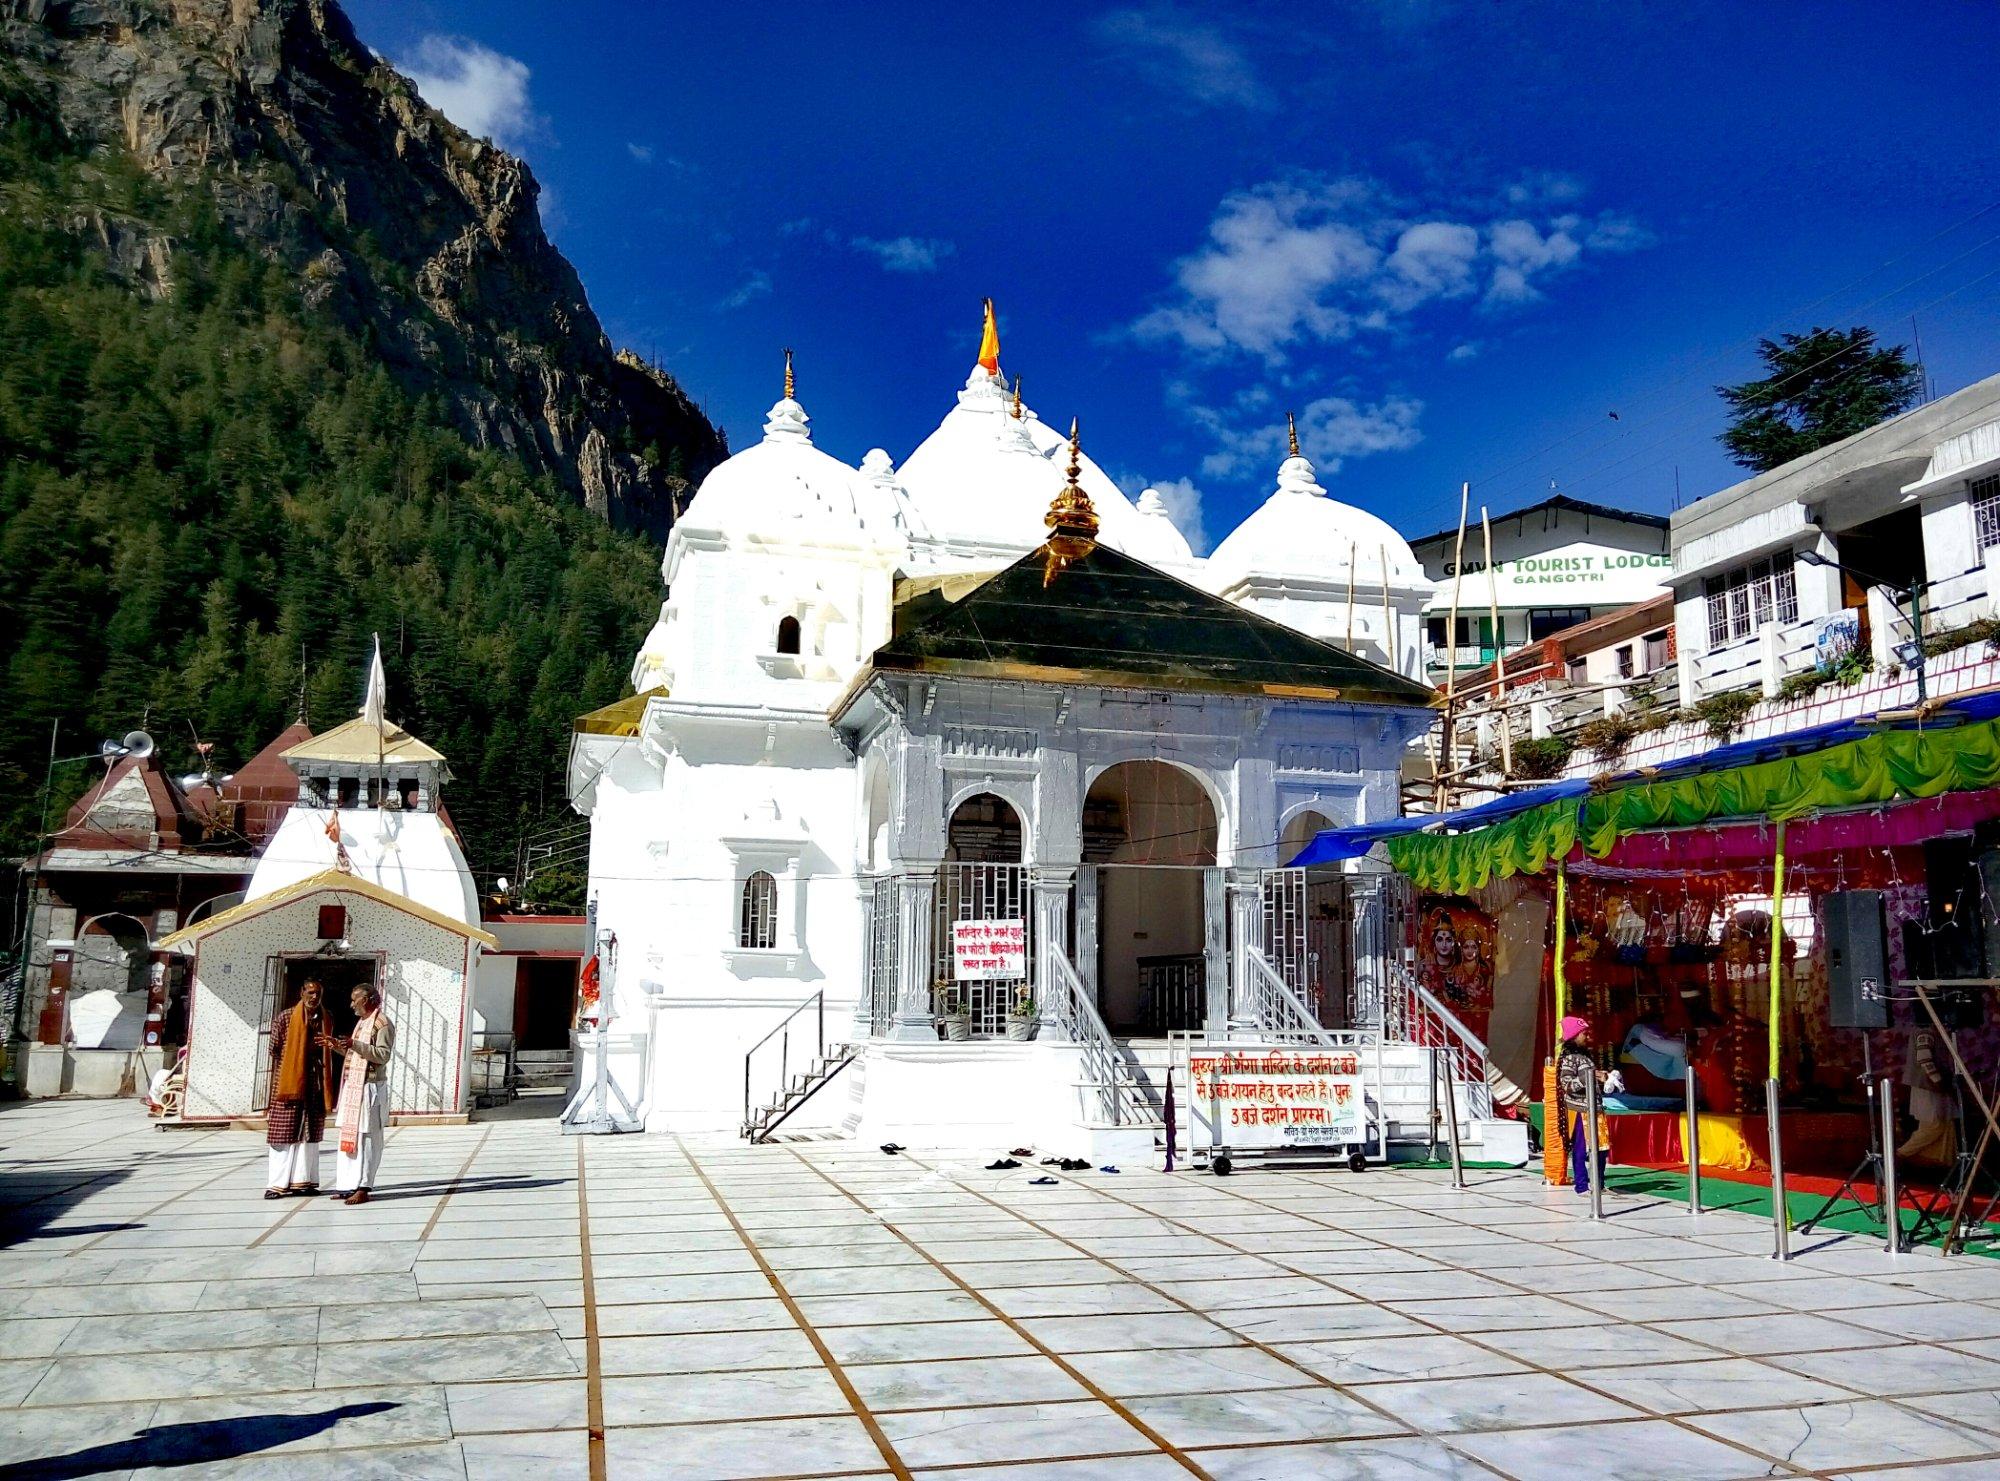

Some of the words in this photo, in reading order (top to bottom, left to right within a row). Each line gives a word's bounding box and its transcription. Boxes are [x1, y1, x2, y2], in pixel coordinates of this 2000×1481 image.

[1514, 556, 1594, 573] TOURIST
[1605, 553, 1672, 569] LODGE
[1513, 572, 1604, 584] GANGOTRI
[1190, 1057, 1216, 1080] मुख्य
[1218, 1052, 1233, 1075] श्री
[1261, 1049, 1291, 1075] मन्दिर
[1293, 1053, 1305, 1073] के
[1306, 1053, 1332, 1075] दर्शन
[1341, 1053, 1357, 1075] बजे
[1196, 1079, 1208, 1099] से
[1209, 1083, 1216, 1100] 3
[1216, 1080, 1231, 1099] बजे
[1231, 1083, 1258, 1099] शयन
[1258, 1079, 1275, 1103] हेतु
[1277, 1083, 1294, 1101] बन्द
[1295, 1080, 1316, 1099] रहते
[1231, 1107, 1240, 1125] 3
[1241, 1104, 1259, 1125] बजे
[1261, 1104, 1288, 1124] दर्शन
